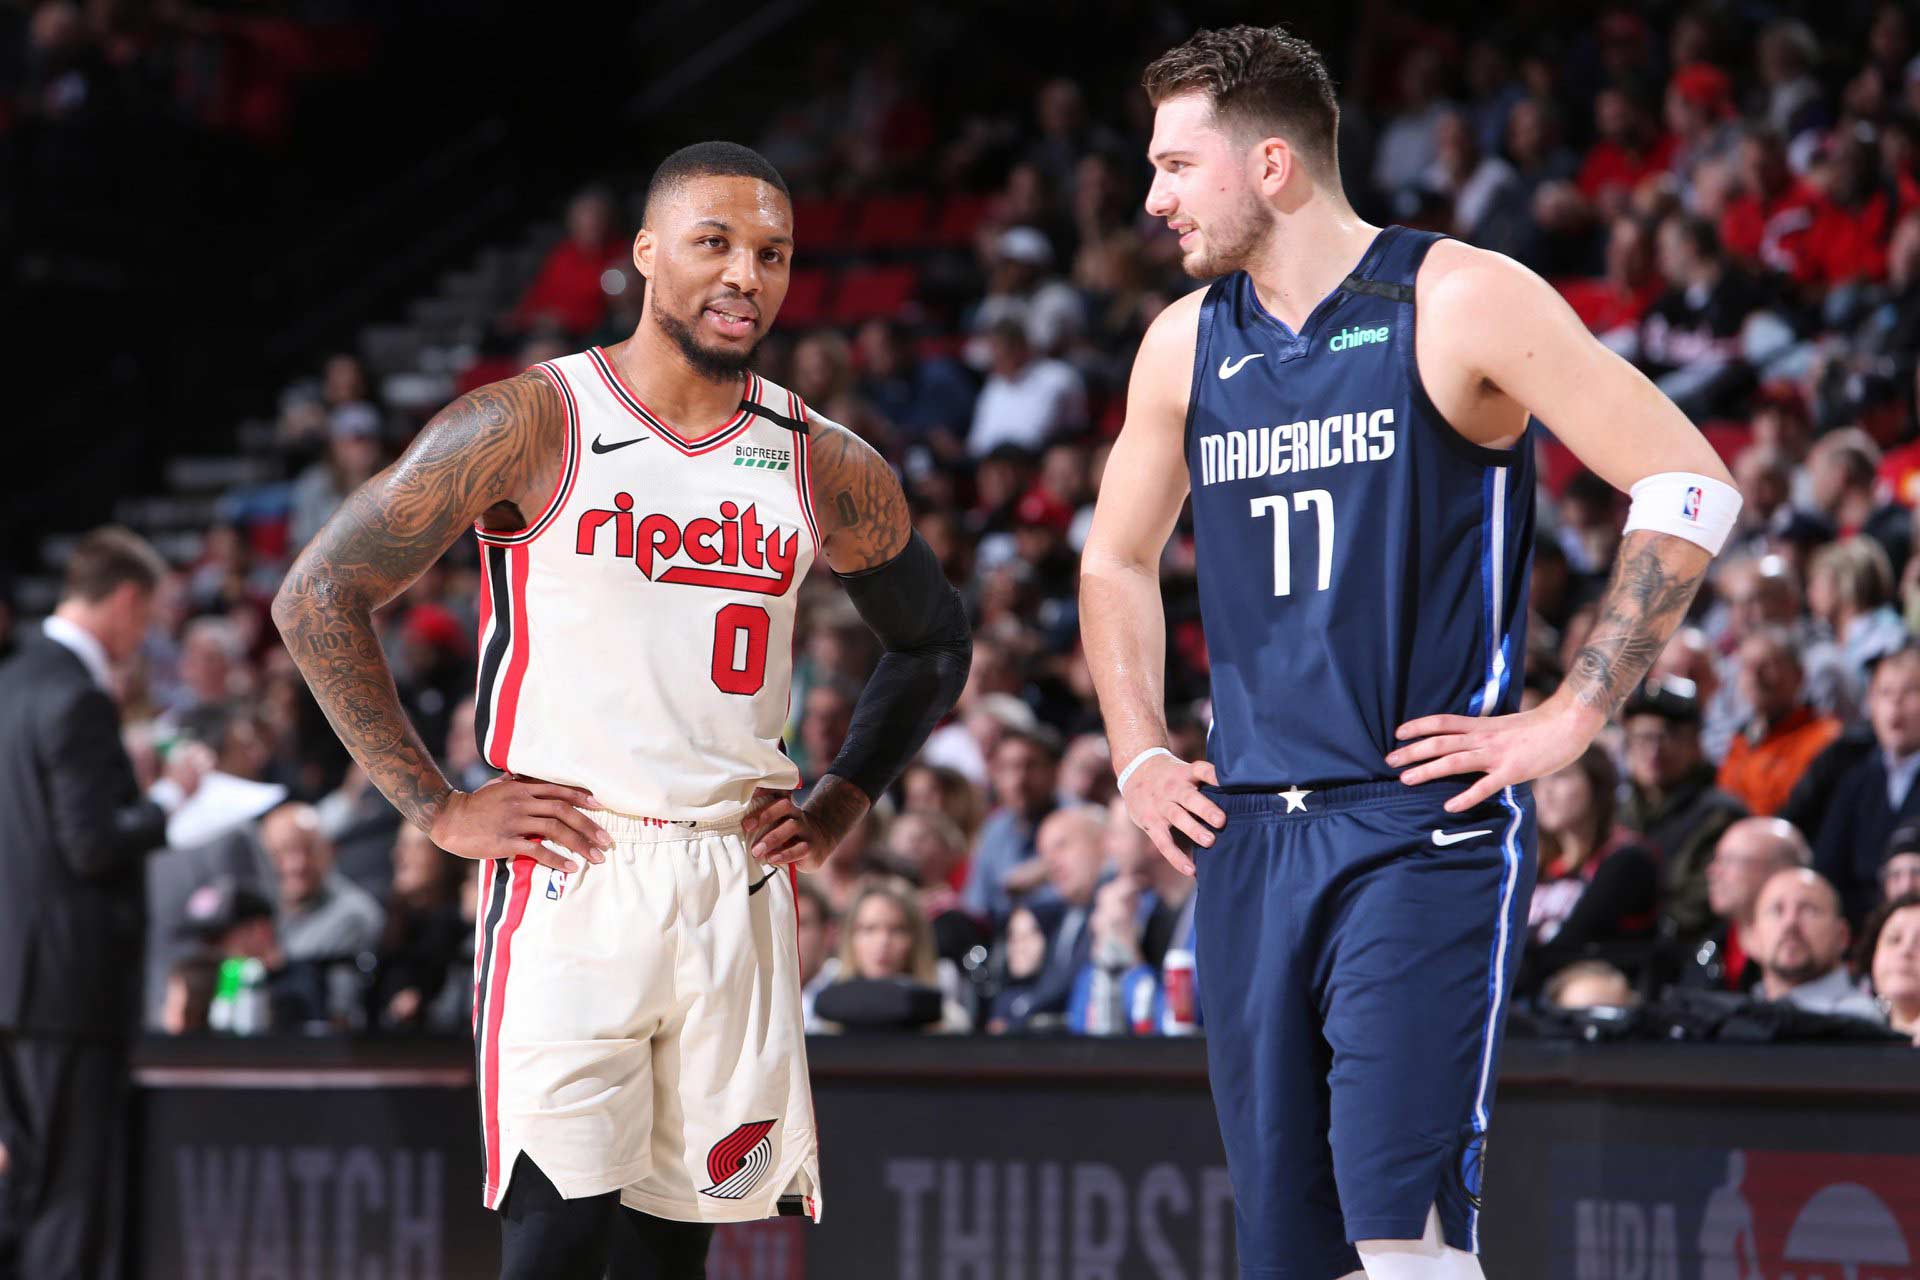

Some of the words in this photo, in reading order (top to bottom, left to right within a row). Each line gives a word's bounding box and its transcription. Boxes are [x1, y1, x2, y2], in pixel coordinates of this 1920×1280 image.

[1329, 326, 1390, 352] chime
[1199, 408, 1396, 486] MAVERICKS
[576, 491, 799, 597] ripcity
[1249, 489, 1335, 597] 77
[711, 603, 771, 696] 0
[175, 1145, 444, 1280] WATCH
